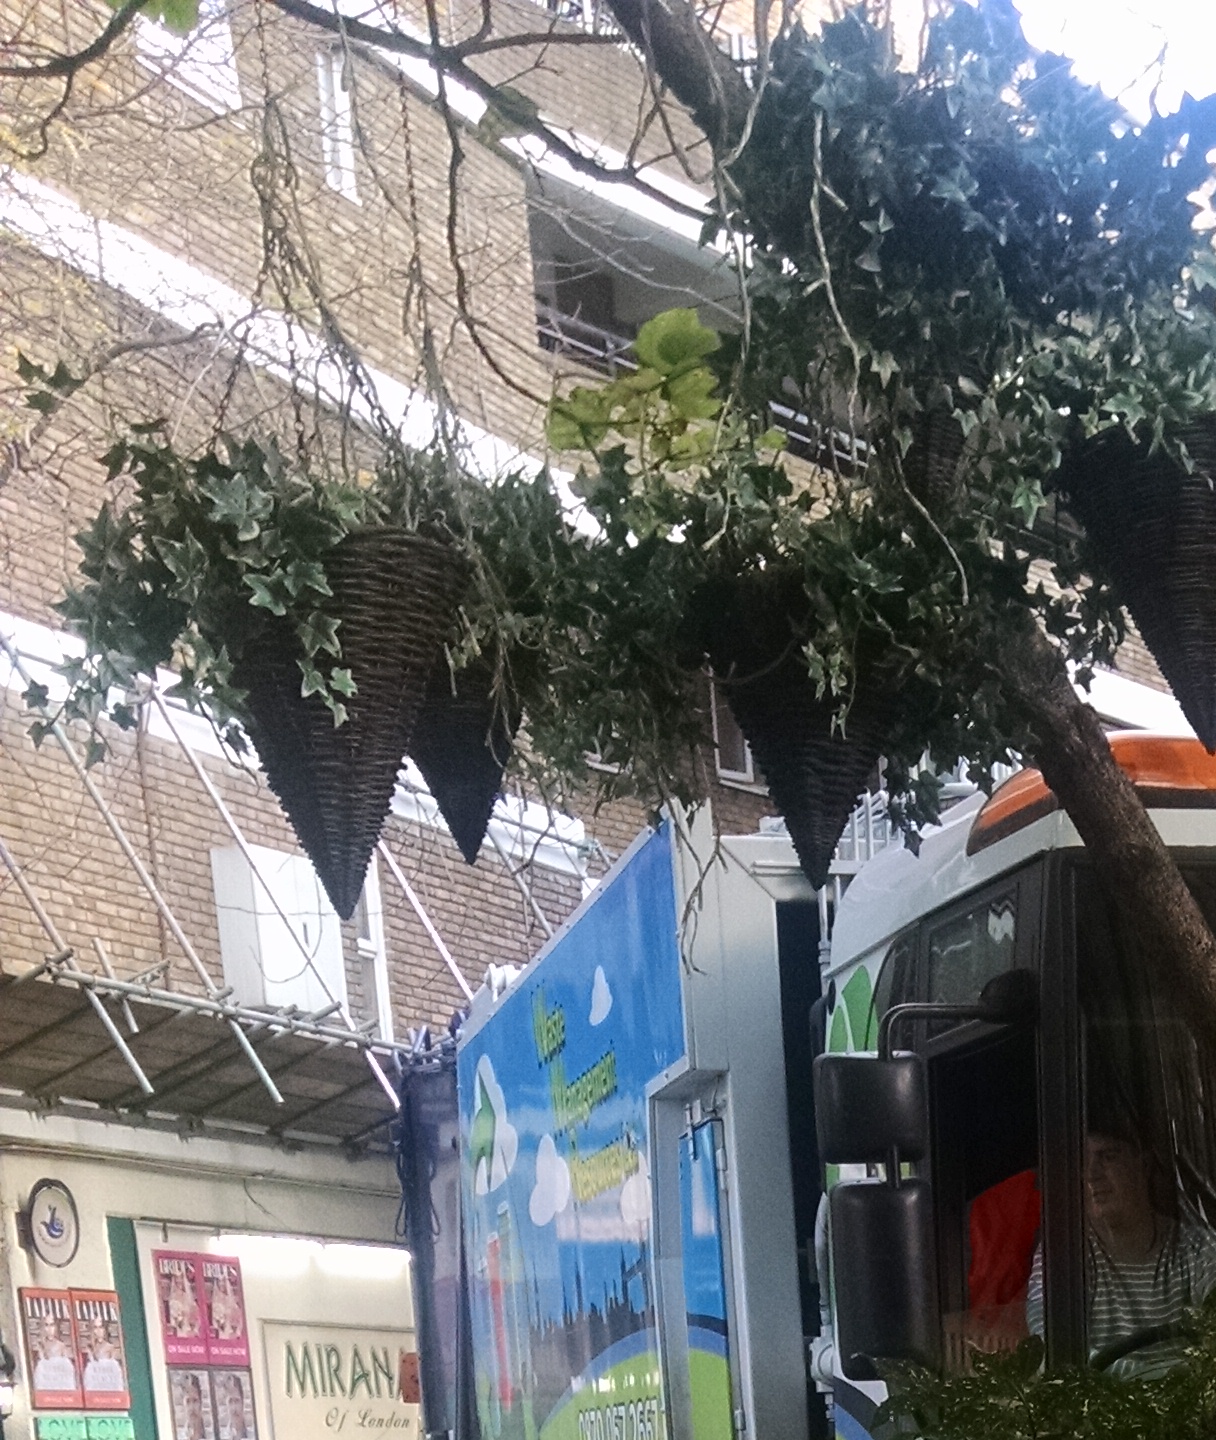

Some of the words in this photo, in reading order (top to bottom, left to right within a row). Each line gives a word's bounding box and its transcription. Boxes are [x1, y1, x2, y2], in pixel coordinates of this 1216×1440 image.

[531, 980, 566, 1068] Waste
[550, 1042, 617, 1136] Management
[325, 1407, 349, 1432] Of
[356, 1411, 410, 1428] London
